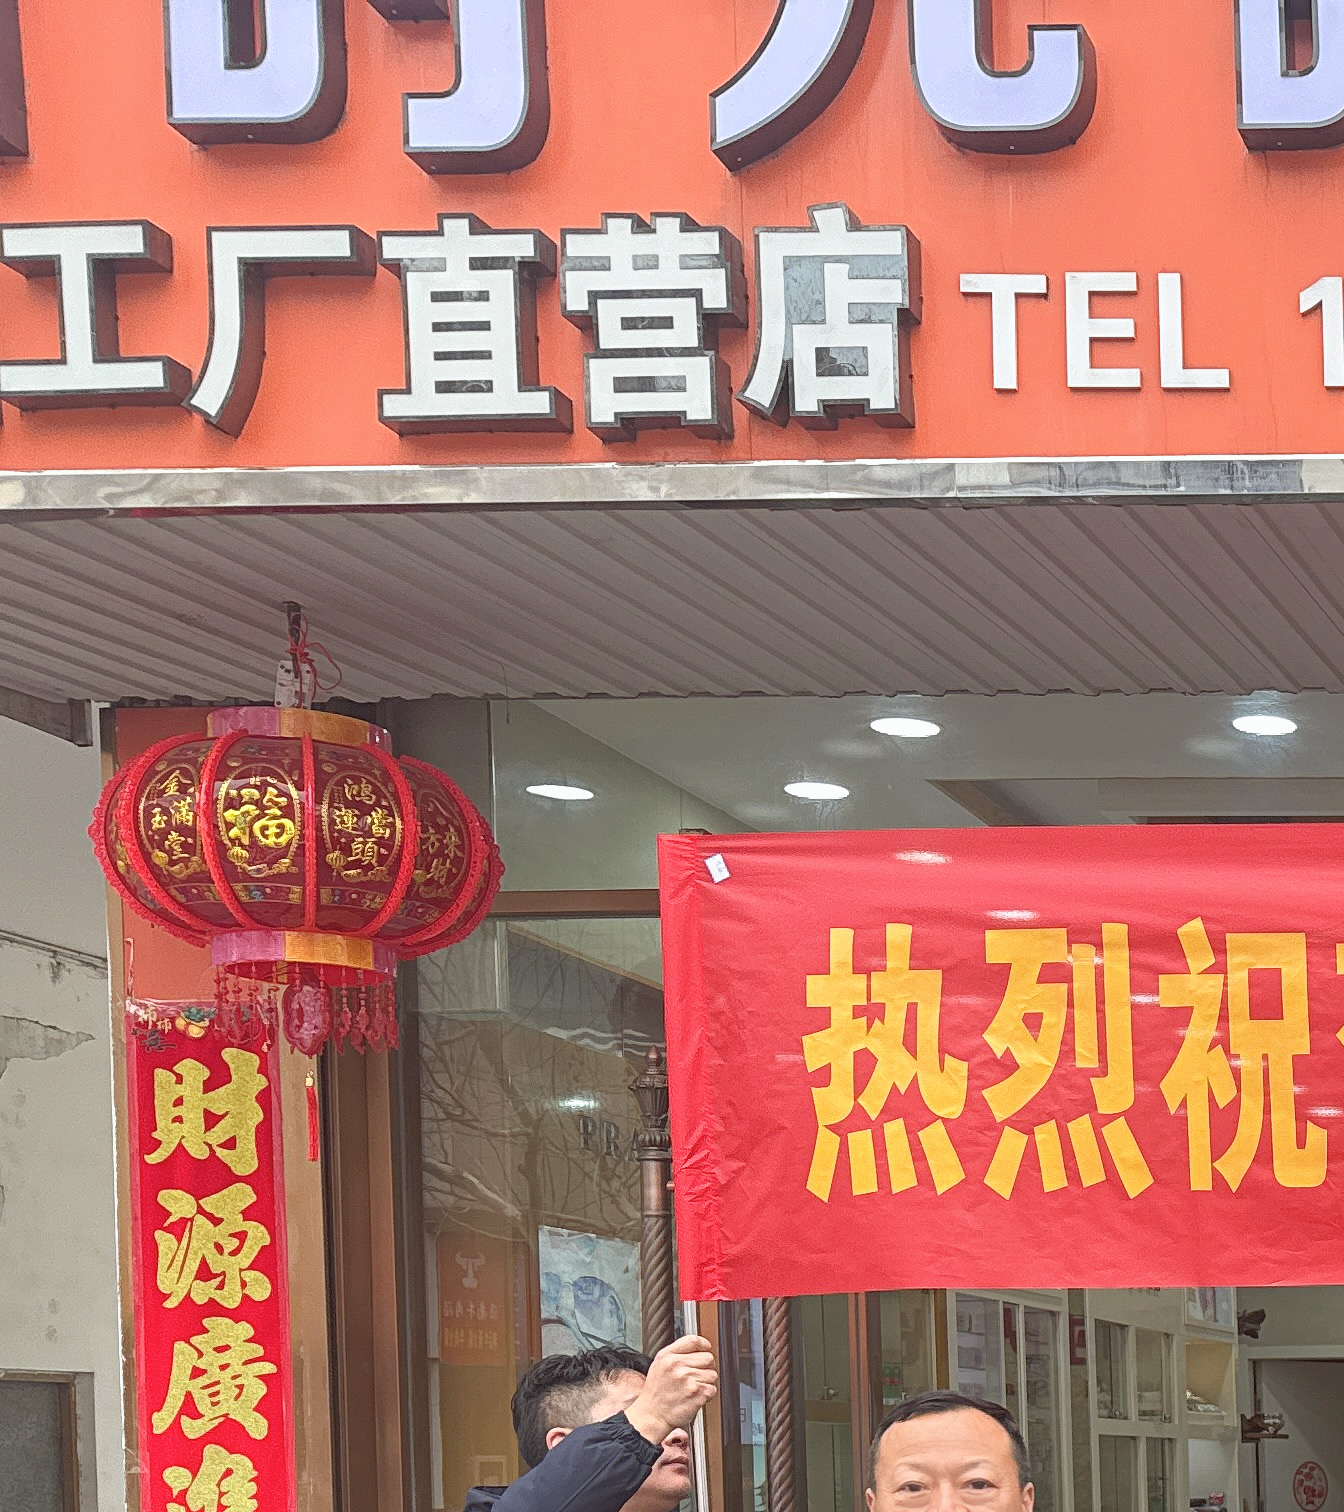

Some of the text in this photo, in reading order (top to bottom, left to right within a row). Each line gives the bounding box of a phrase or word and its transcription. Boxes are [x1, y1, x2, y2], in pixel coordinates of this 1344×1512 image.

[0, 204, 917, 438] 工厂直营店
[960, 271, 1230, 392] TEL
[223, 786, 295, 850] 福
